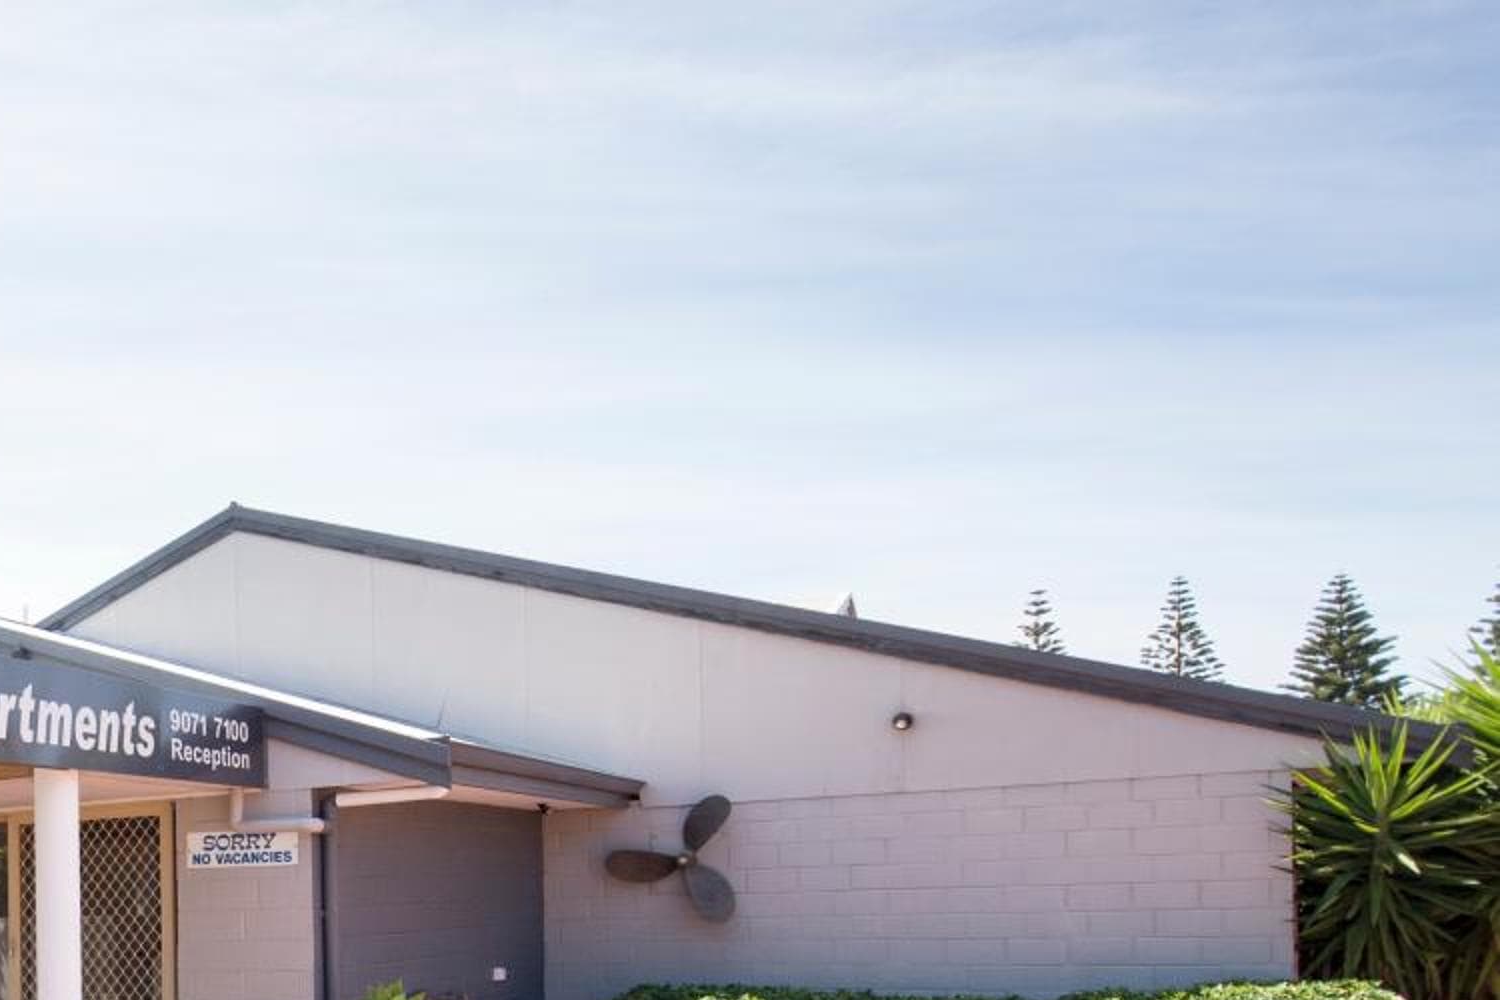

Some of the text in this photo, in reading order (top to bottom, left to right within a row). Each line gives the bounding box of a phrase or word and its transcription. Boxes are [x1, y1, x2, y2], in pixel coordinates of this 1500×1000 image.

[170, 709, 249, 742] 9071 7100
[171, 738, 250, 771] Reception
[203, 833, 276, 851] SORRY
[192, 851, 293, 865] NO VACANCIES
